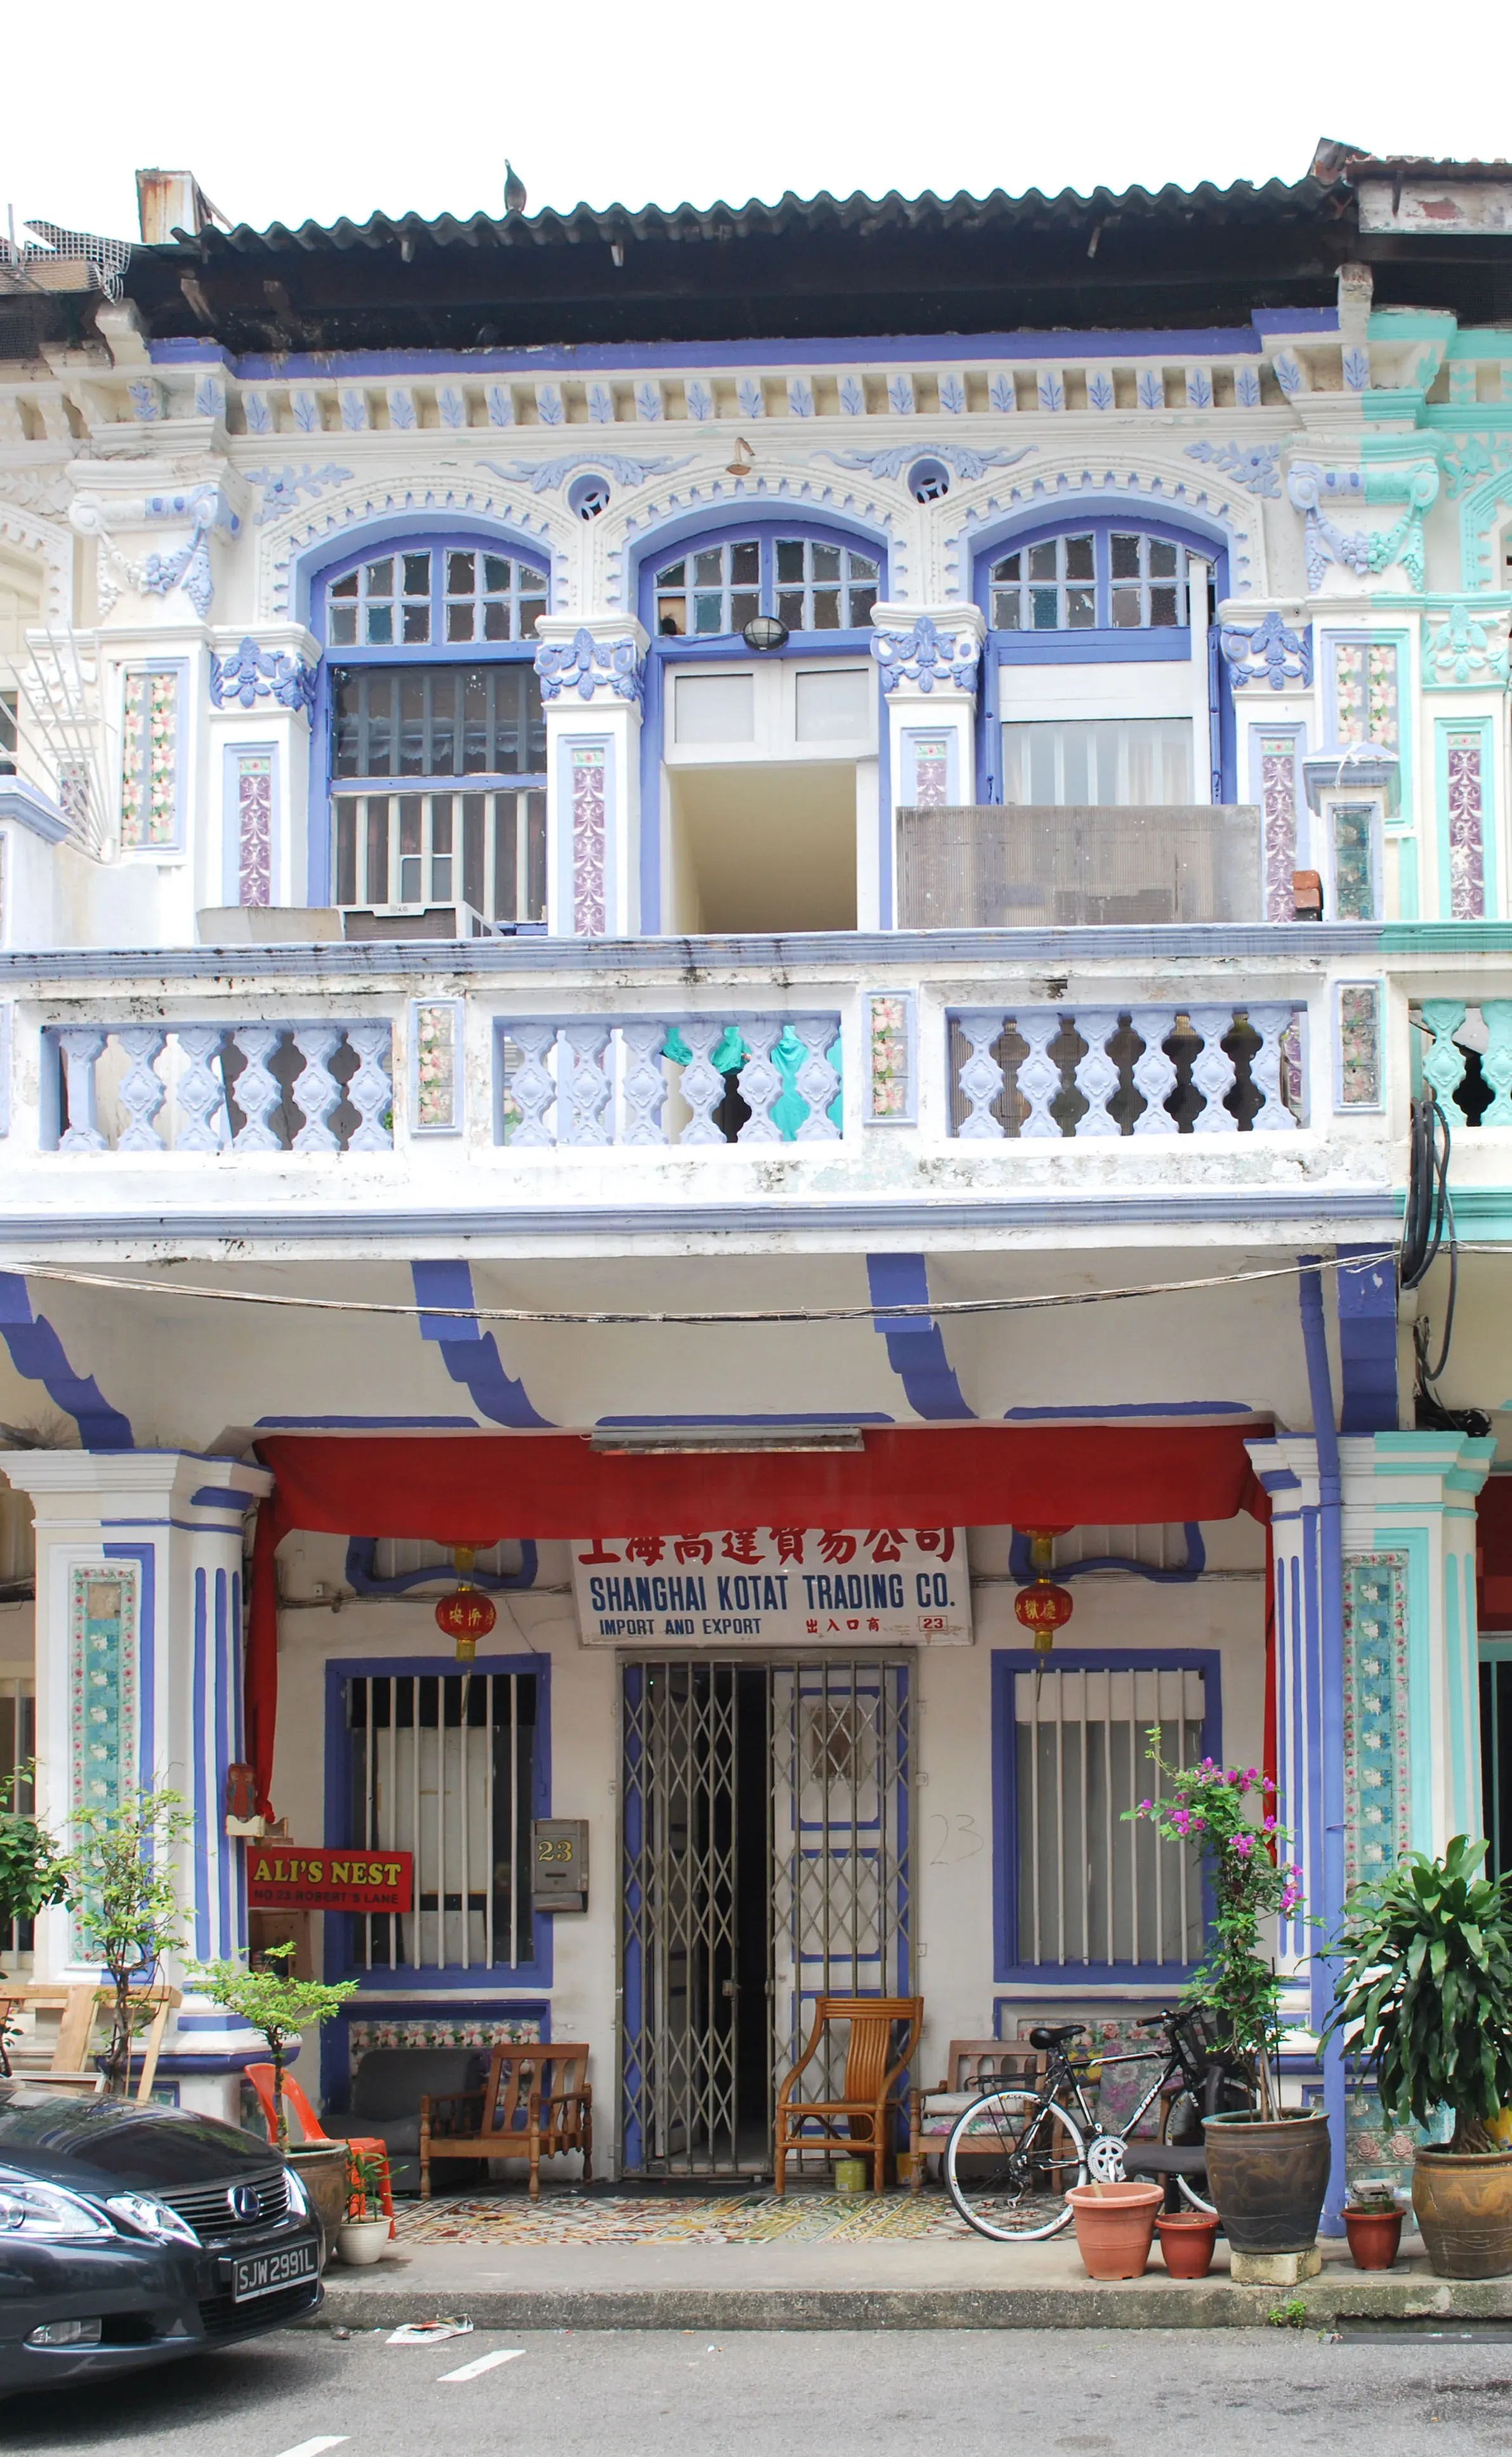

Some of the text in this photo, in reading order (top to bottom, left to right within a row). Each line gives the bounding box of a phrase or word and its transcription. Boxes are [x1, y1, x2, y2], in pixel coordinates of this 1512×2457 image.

[589, 1572, 956, 1612] SHANGHAI KOTAT TRADING CO.
[600, 1617, 761, 1636] IMPORT AND EXPORT
[806, 1617, 880, 1634] 出入口商
[923, 1618, 943, 1629] 23
[930, 1814, 985, 1866] 23
[538, 1840, 573, 1862] 23
[253, 1859, 402, 1887] ALI'S NEST
[254, 1888, 273, 1900] NO
[275, 1889, 291, 1900] 23
[364, 1893, 399, 1904] LANE
